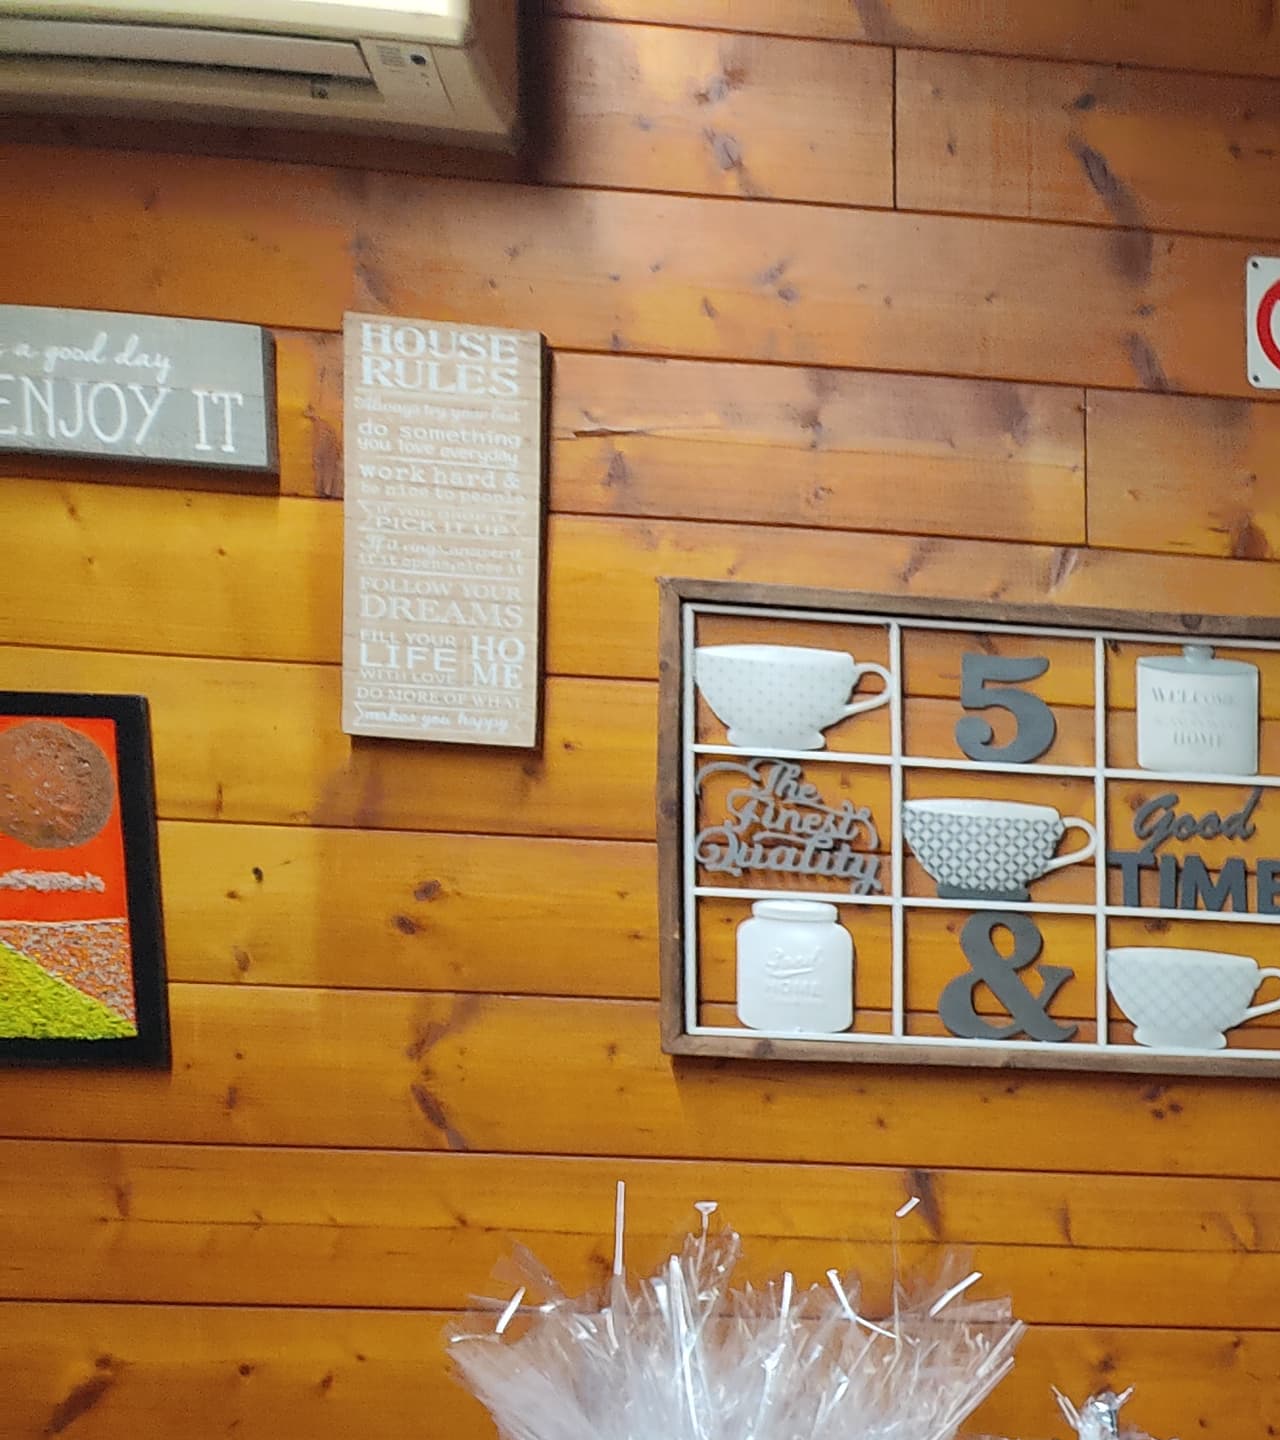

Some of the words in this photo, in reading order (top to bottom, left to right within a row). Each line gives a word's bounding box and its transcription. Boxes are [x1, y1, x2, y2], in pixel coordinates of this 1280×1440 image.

[15, 343, 34, 358] a
[43, 331, 108, 373] good
[113, 333, 172, 384] day
[361, 322, 519, 365] HOUSE
[361, 353, 519, 397] RULES
[0, 374, 172, 445] ENJOY
[192, 389, 243, 453] IT
[358, 418, 388, 436] do
[400, 425, 521, 450] something
[358, 437, 391, 452] you
[399, 439, 435, 454] love
[359, 463, 426, 483] work
[433, 466, 496, 489] hard
[503, 471, 520, 490] &
[376, 515, 437, 533] PICK
[444, 520, 464, 535] IT
[474, 523, 510, 537] UP
[360, 575, 450, 597] FOLLOW
[462, 583, 522, 601] YOUR
[360, 593, 523, 629] DREAMS
[360, 628, 397, 643] FILL
[404, 631, 457, 648] YOUR
[472, 634, 526, 664] HO
[360, 642, 457, 673] LIFE
[472, 661, 523, 690] ME
[356, 687, 384, 699] DO
[388, 688, 440, 705] MORE
[443, 693, 467, 706] OF
[472, 694, 522, 710] WHAT
[955, 652, 1057, 764] 5
[696, 758, 824, 804] The
[727, 788, 878, 849] Finest
[1133, 786, 1264, 859] Good
[696, 820, 883, 895] Quality
[938, 910, 1078, 1042] &
